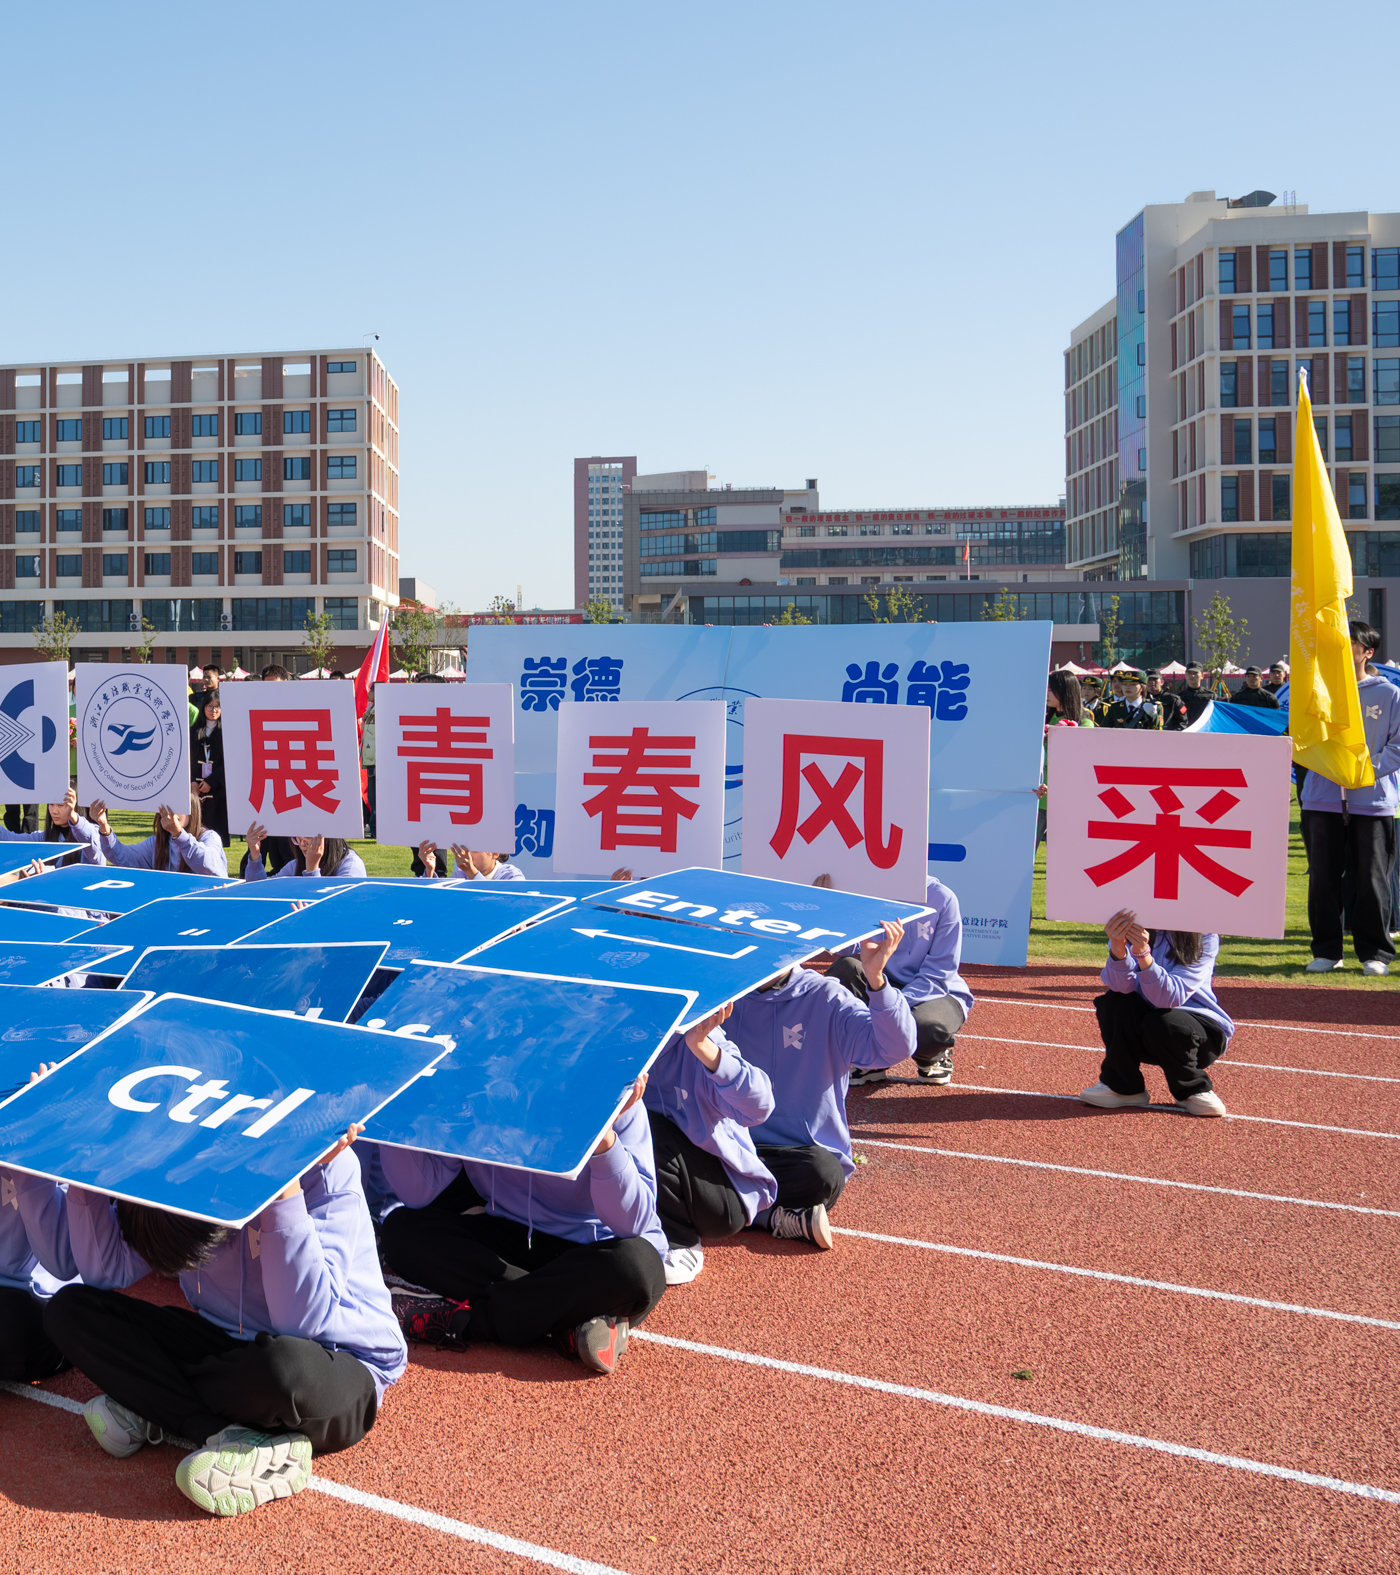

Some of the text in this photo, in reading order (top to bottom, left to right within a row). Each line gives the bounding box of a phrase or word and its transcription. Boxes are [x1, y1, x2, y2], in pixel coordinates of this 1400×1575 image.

[103, 769, 123, 788] College
[123, 783, 131, 791] of
[130, 780, 155, 791] Security
[153, 746, 175, 782] Technology
[248, 708, 341, 815] 展
[397, 707, 494, 825] 青
[581, 727, 700, 853] 春
[768, 733, 904, 870] 风
[82, 879, 135, 891] P
[1083, 764, 1255, 901] 采
[615, 889, 847, 941] Enter
[107, 1064, 317, 1139] Ctrl
